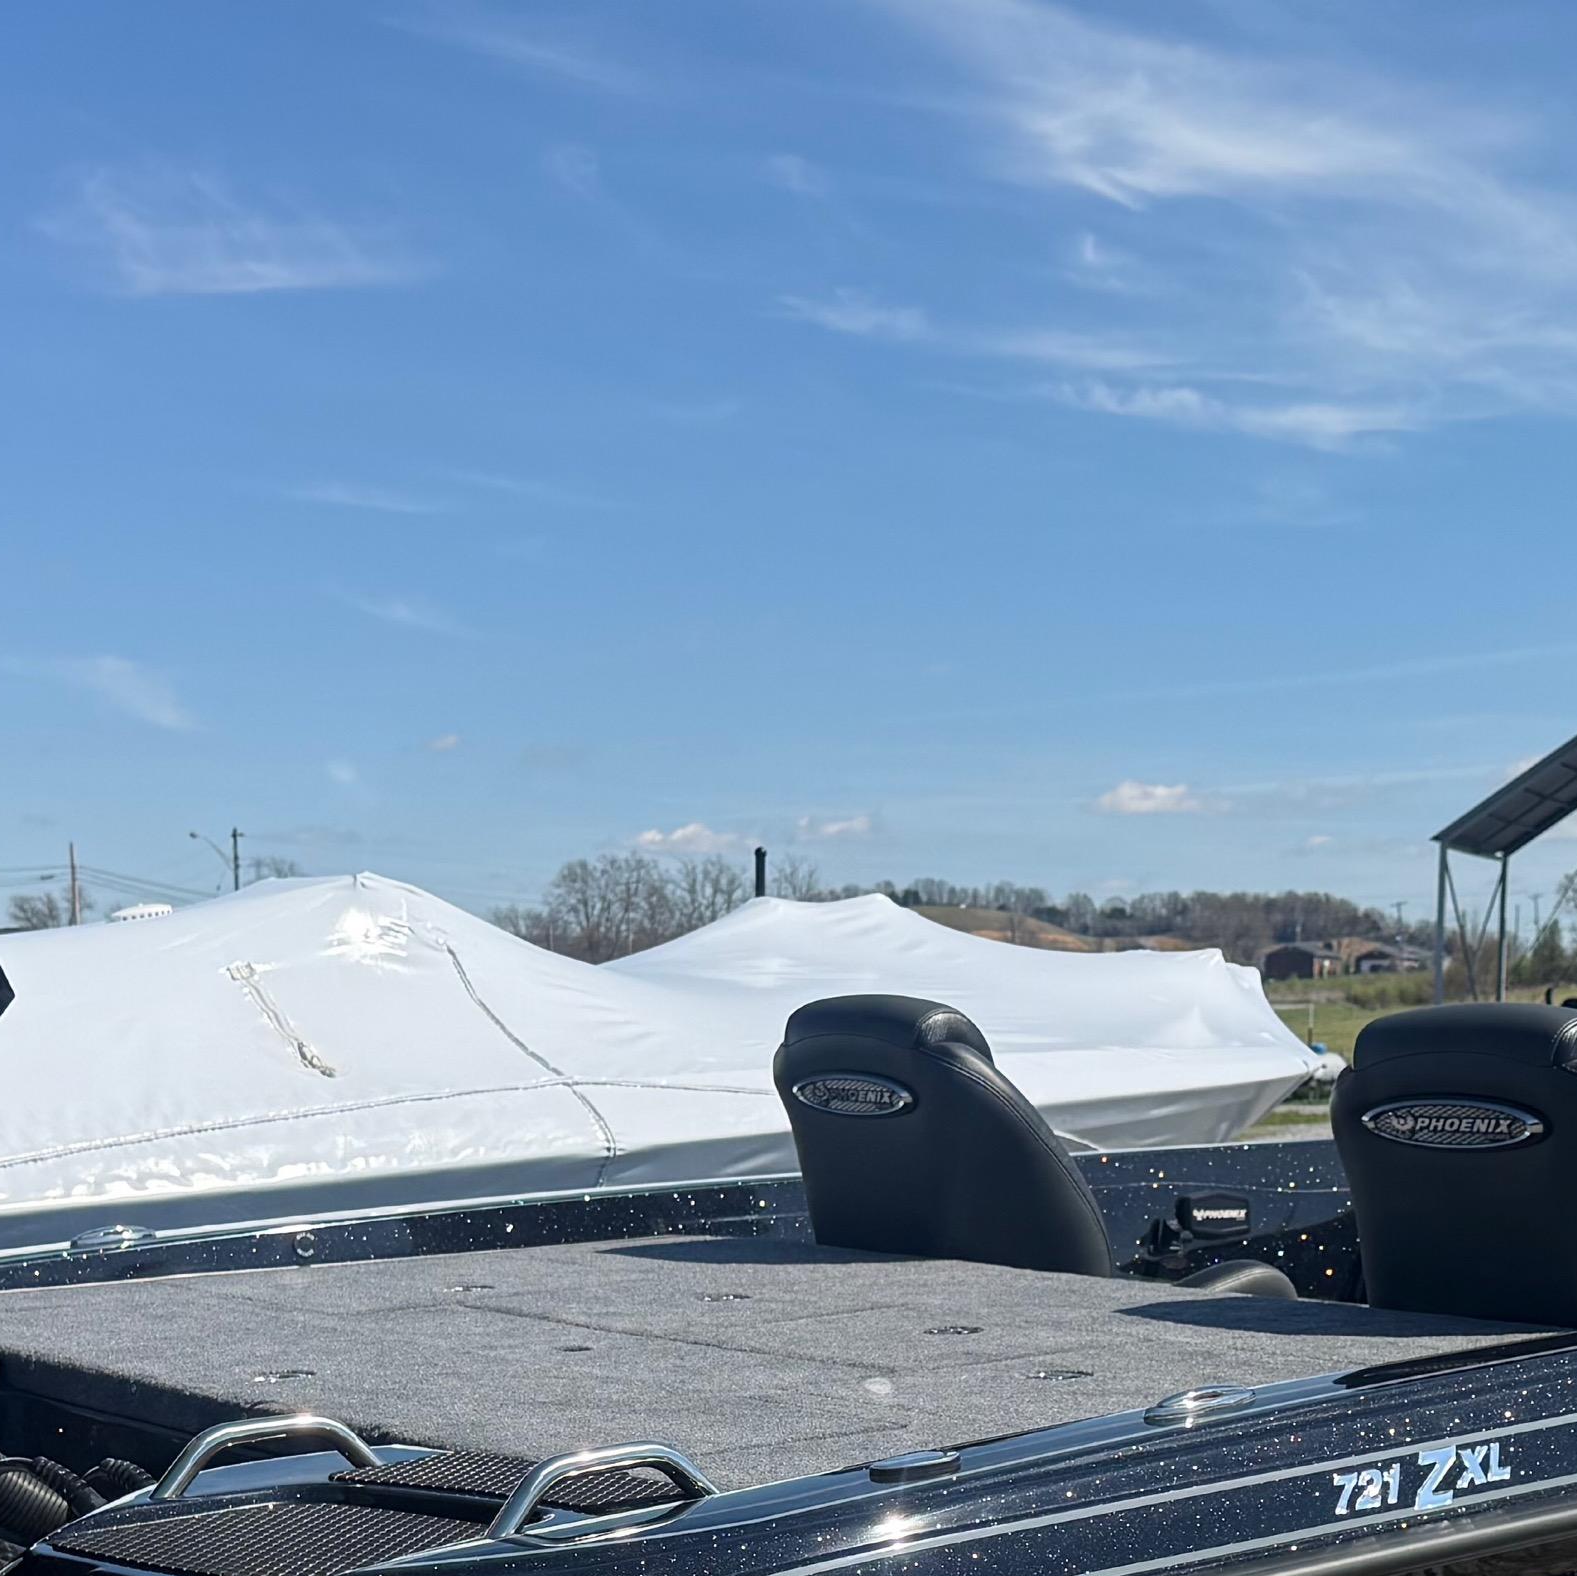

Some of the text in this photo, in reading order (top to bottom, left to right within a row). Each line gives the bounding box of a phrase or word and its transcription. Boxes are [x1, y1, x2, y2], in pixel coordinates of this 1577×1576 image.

[828, 1088, 891, 1104] PHOENIX
[1415, 1117, 1512, 1134] PHOENIX
[1332, 1462, 1401, 1516] 721
